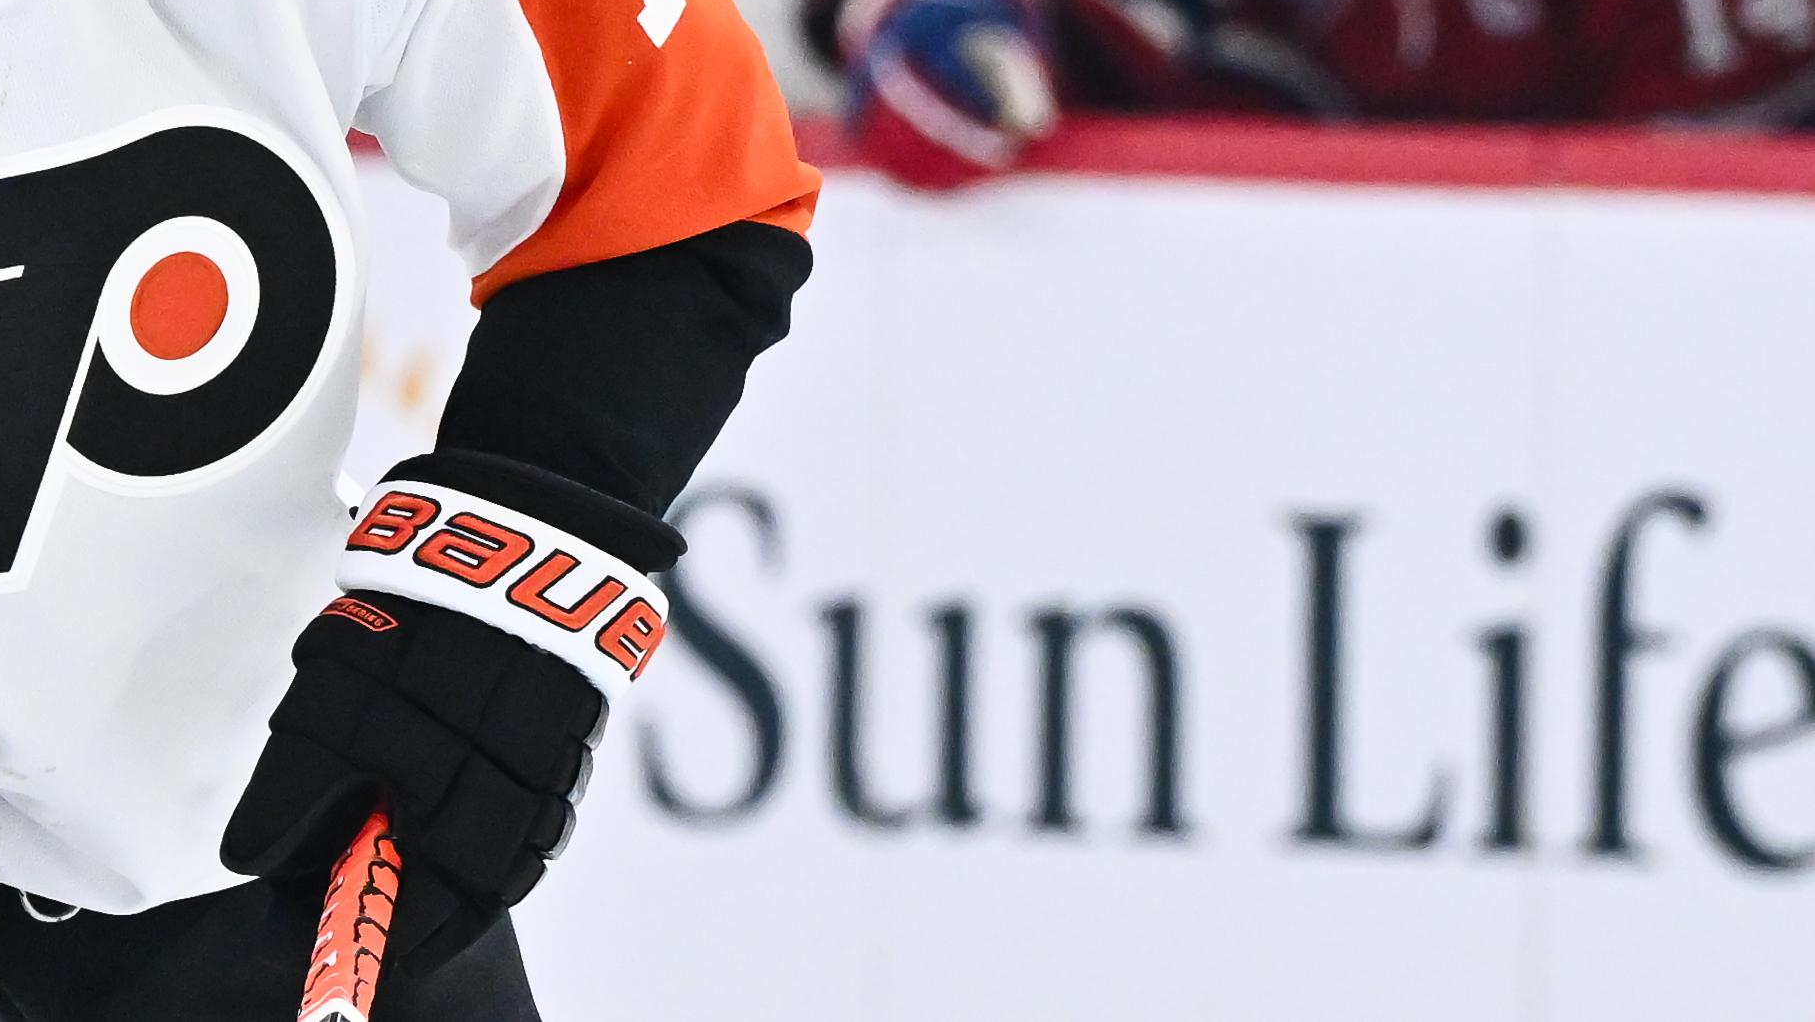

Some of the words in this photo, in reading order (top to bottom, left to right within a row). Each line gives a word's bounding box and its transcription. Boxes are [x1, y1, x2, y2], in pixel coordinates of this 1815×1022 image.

[344, 490, 668, 682] BAUE
[635, 480, 1196, 840] Sun
[1288, 486, 1815, 876] Life
